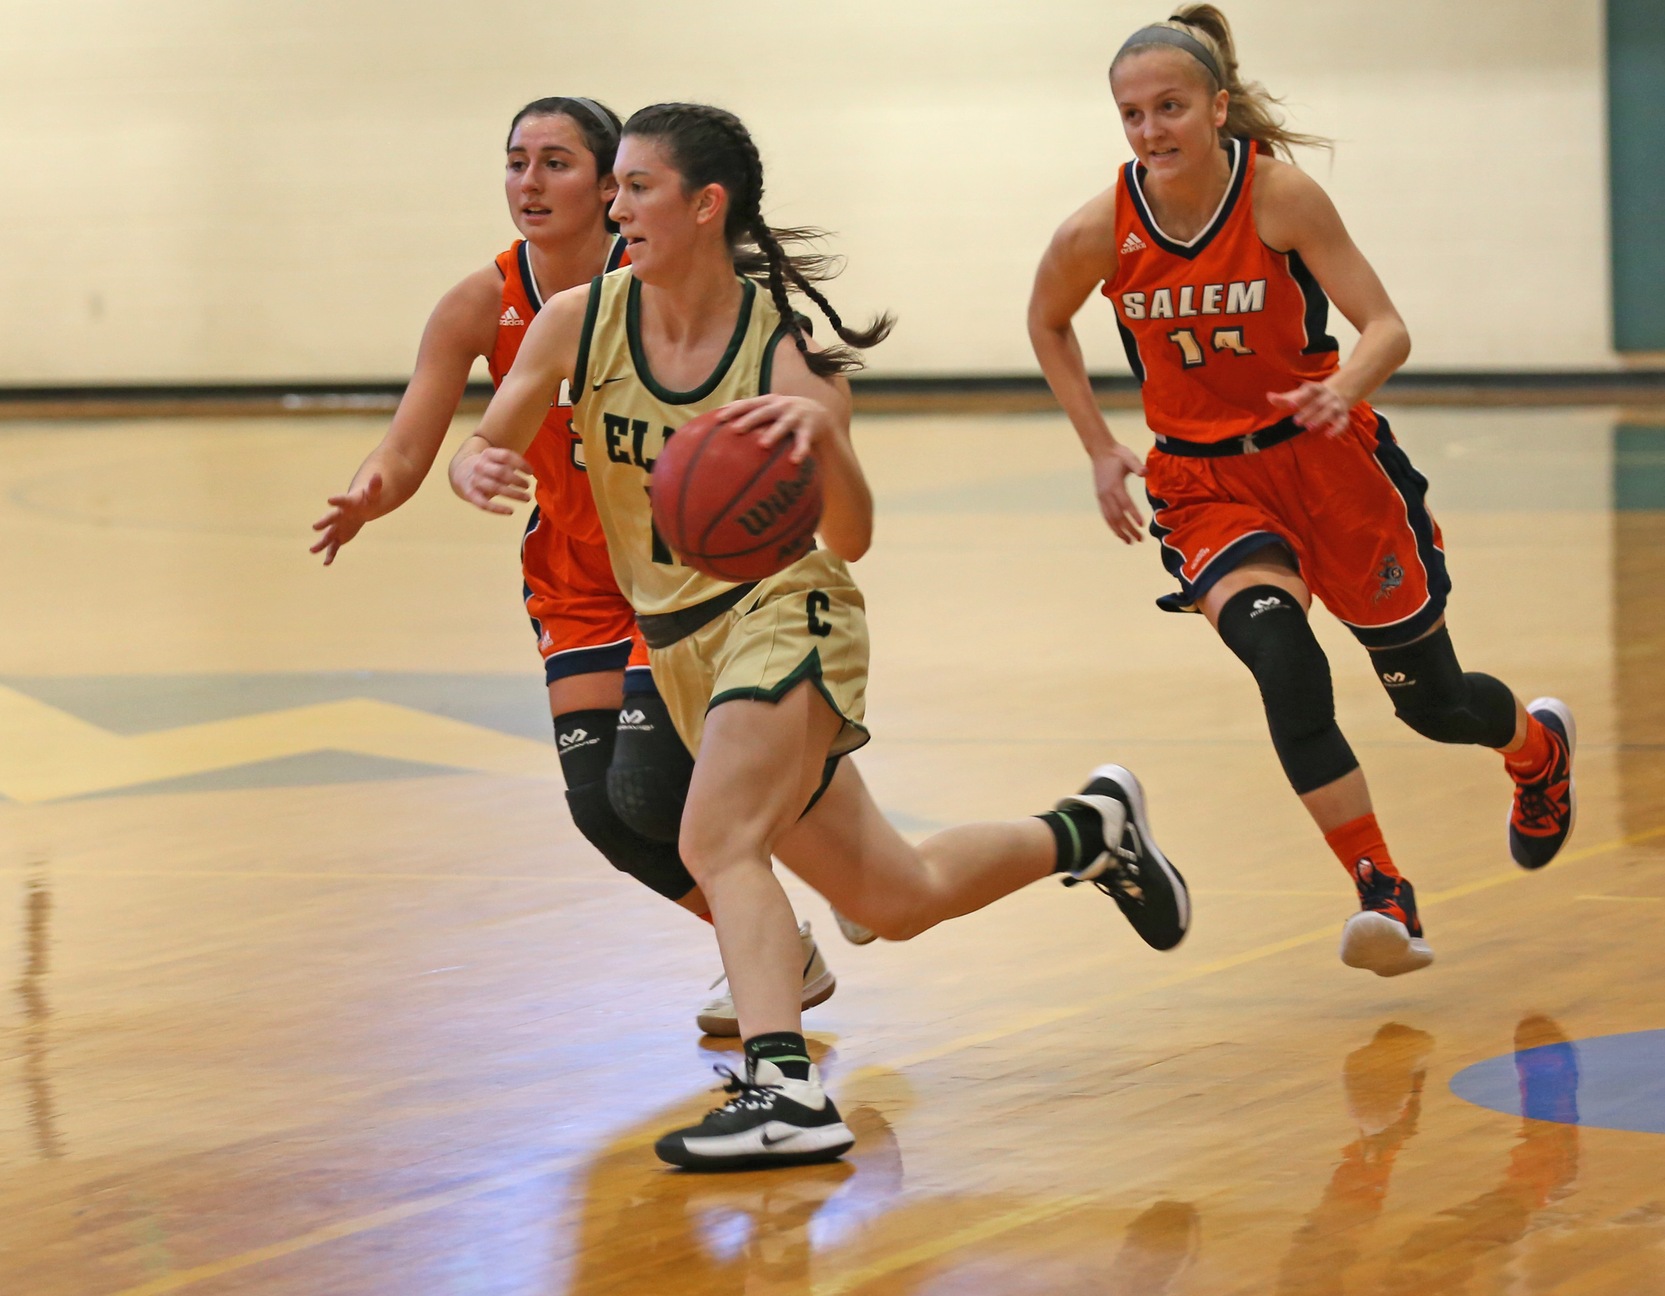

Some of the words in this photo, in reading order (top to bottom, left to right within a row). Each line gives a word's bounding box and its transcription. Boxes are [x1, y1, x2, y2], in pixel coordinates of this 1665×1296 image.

[1120, 242, 1147, 255] adidas
[1122, 278, 1267, 320] SALEM
[806, 589, 832, 638] C
